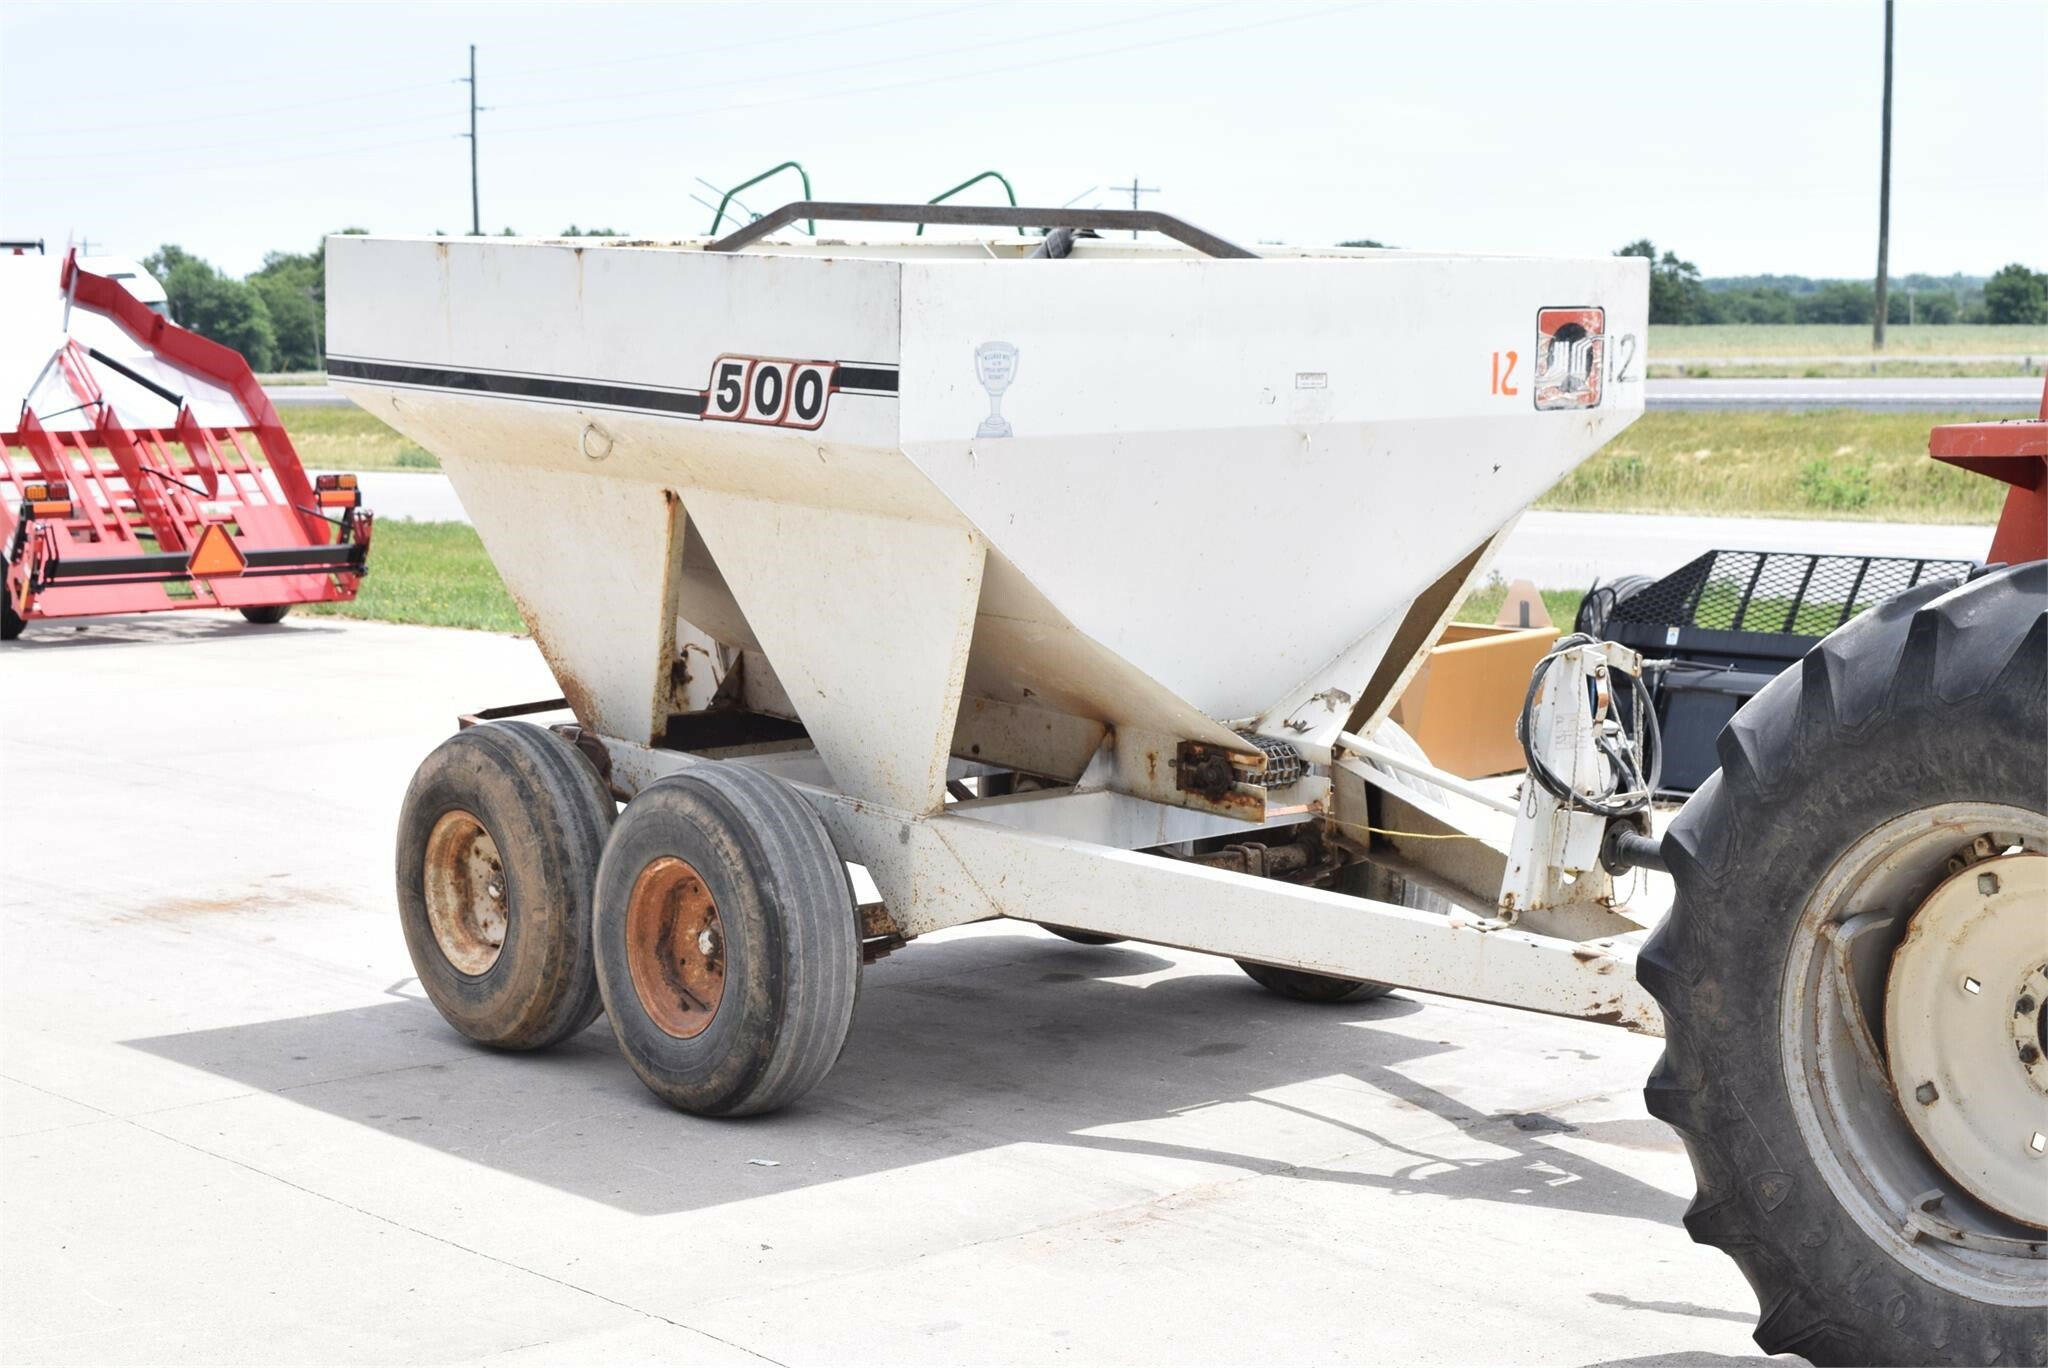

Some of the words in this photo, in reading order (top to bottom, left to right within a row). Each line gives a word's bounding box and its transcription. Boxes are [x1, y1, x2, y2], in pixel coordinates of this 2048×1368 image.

[1492, 351, 1518, 395] 12
[1607, 333, 1639, 383] 12
[716, 364, 823, 420] 500
